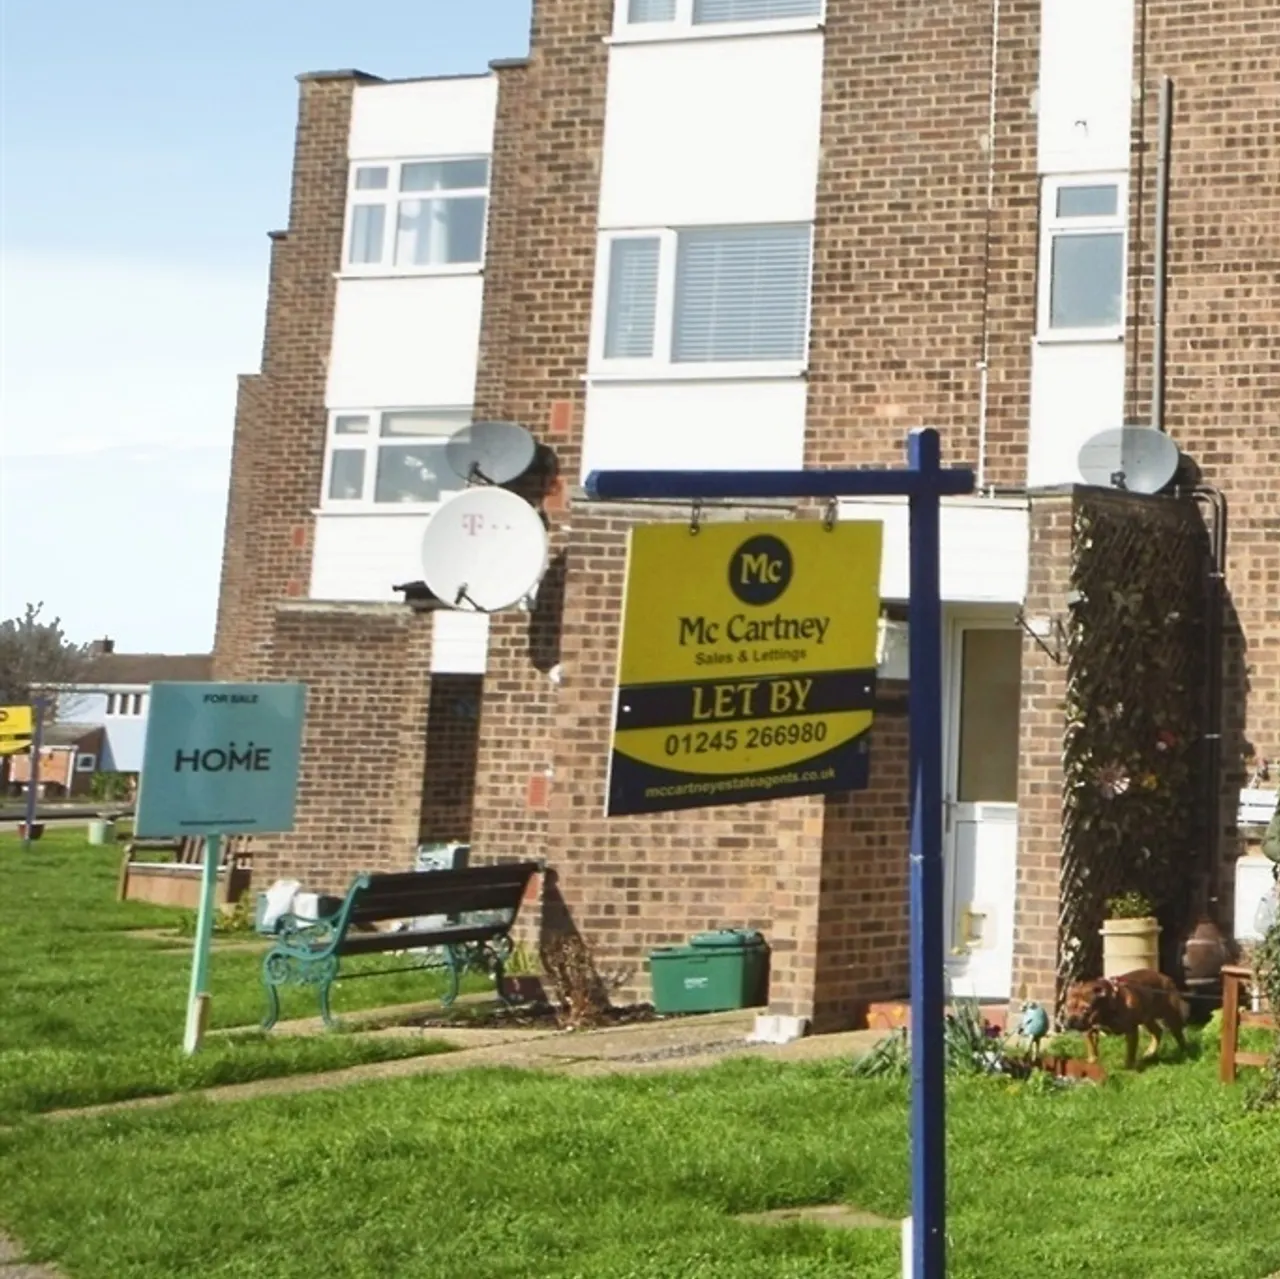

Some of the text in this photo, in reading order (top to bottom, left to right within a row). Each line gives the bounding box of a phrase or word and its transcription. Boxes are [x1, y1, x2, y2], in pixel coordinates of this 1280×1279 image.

[740, 553, 783, 584] Mc
[679, 613, 831, 646] Mc Cartney
[695, 648, 807, 666] Sales & Lettings
[203, 693, 229, 704] FOR
[692, 678, 813, 719] LET BY
[665, 721, 828, 756] 01245 266980
[174, 741, 272, 773] HOME
[645, 767, 836, 798] mccartneyestateagents.co.uk
